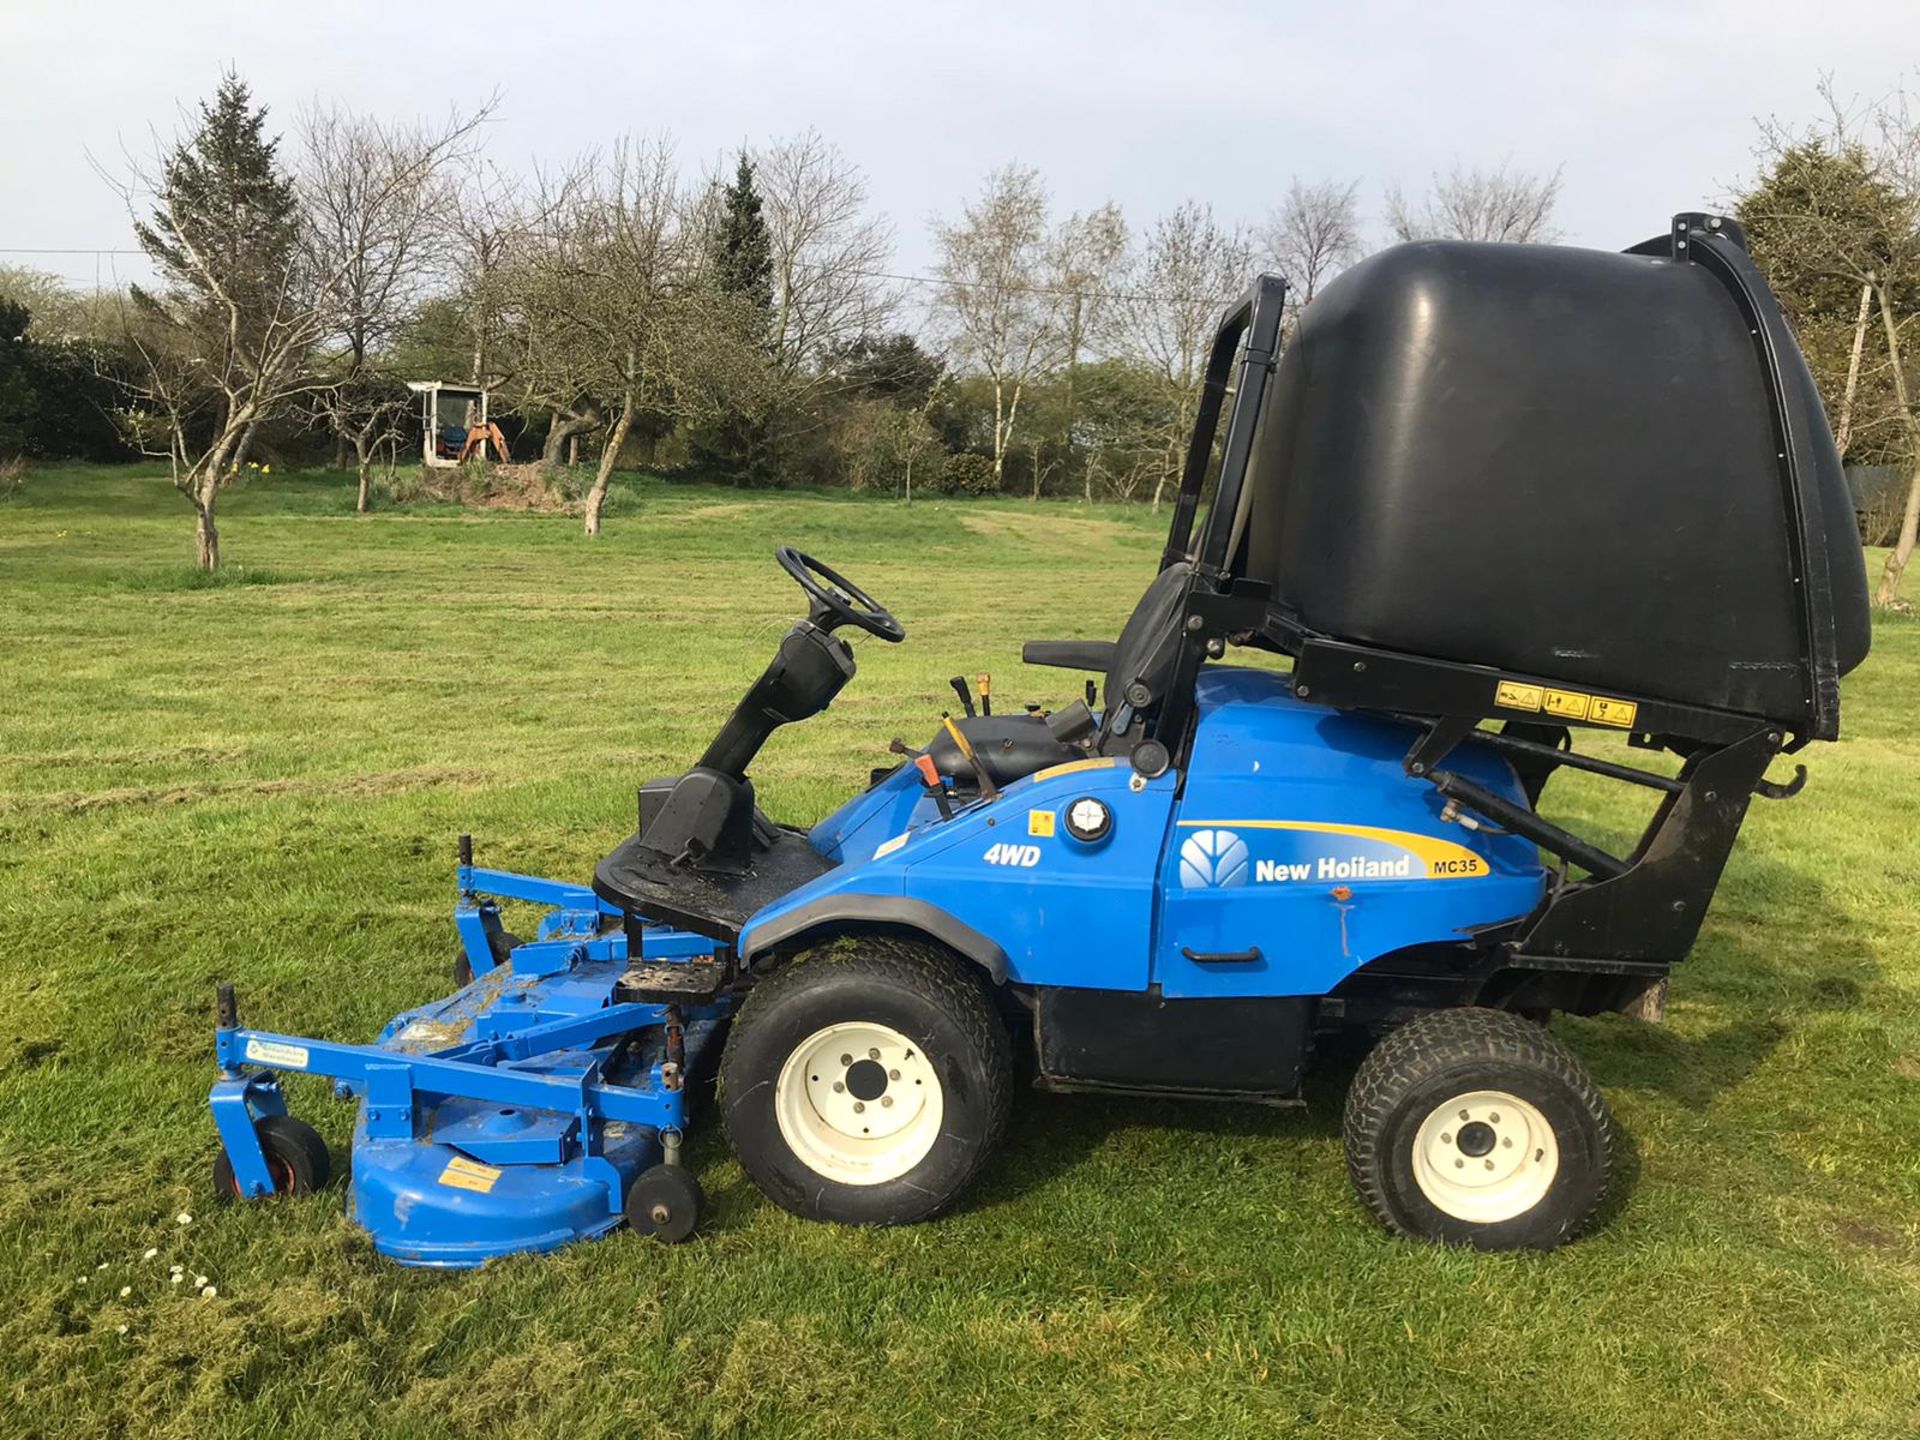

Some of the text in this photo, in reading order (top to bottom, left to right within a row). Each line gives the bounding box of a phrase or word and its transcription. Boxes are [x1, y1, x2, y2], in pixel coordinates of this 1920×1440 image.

[983, 843, 1041, 867] 4WD
[1256, 860, 1311, 882] New
[1433, 858, 1478, 875] MC35
